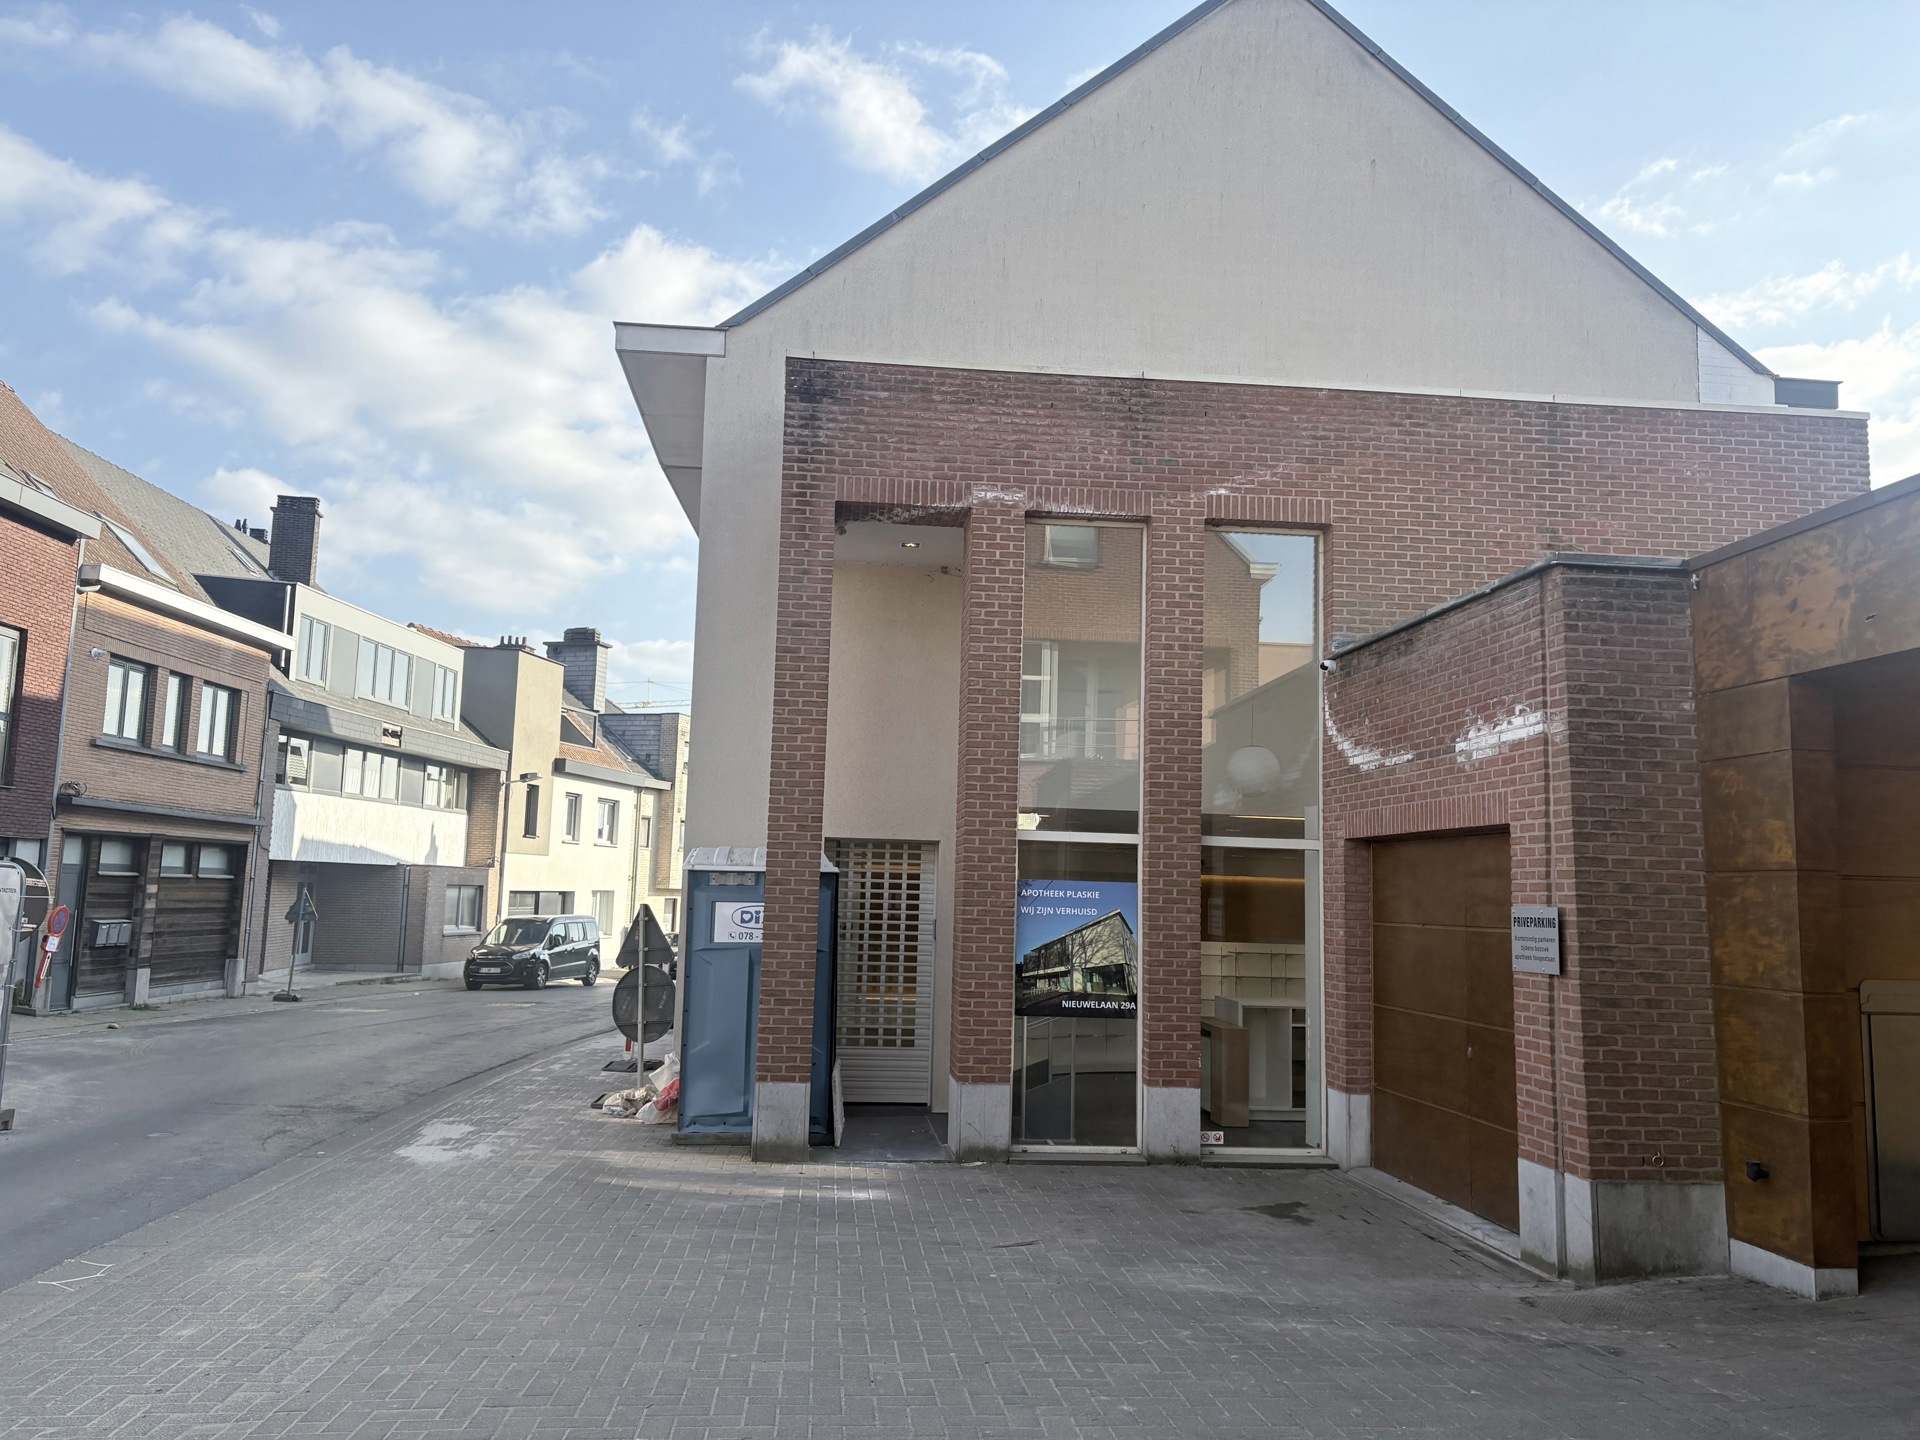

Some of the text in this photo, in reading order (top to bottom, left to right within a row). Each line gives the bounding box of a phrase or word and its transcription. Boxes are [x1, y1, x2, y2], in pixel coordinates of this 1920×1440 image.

[1021, 889, 1100, 899] APOTHEEK PLASKIE
[1021, 906, 1098, 916] WIJ ZIJN VERHUISD
[740, 910, 765, 924] Di
[1513, 917, 1556, 928] PRIVEPARKING
[738, 932, 754, 940] 078
[1533, 955, 1557, 963] toegestaan.
[1062, 1000, 1136, 1010] NIEUWELAAN 29A
